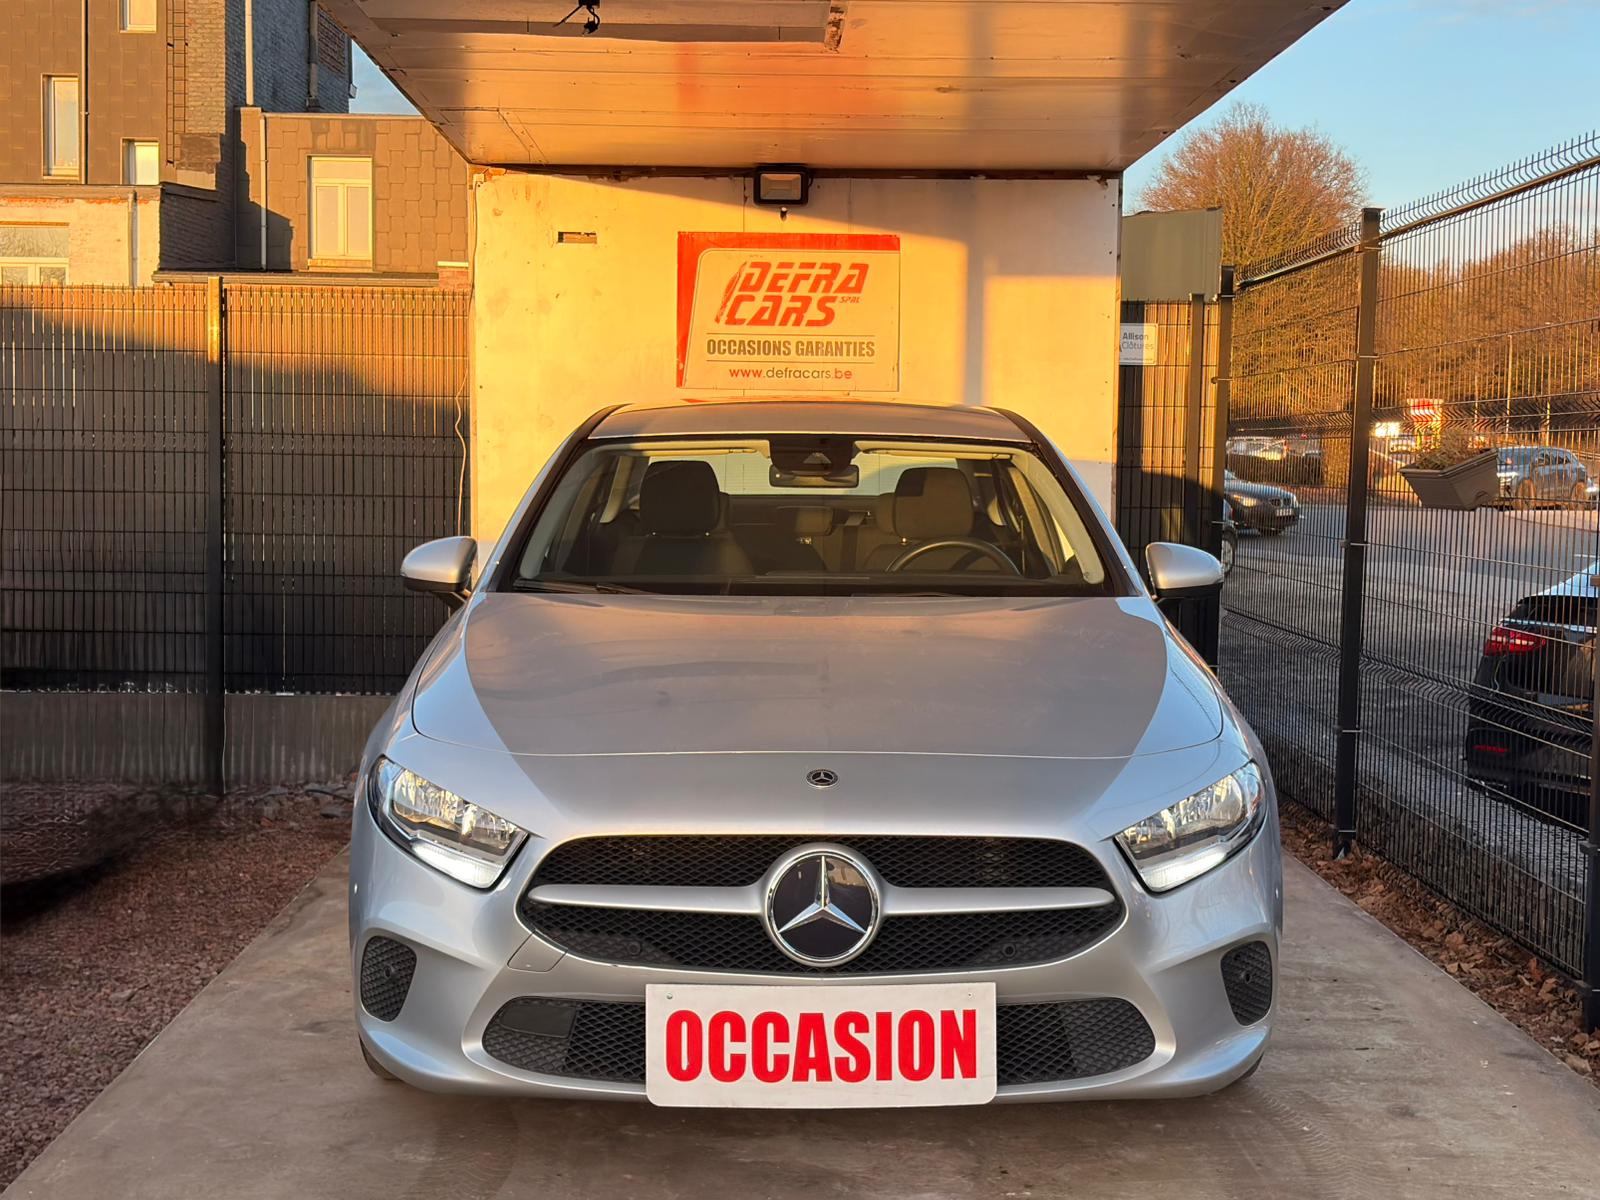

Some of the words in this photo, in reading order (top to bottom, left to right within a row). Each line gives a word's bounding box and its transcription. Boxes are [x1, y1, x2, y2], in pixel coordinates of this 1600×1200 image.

[738, 261, 870, 294] DEFRA
[724, 294, 837, 327] CARS
[706, 339, 792, 356] OCCASIONS
[795, 341, 875, 357] GARANTIES
[1122, 332, 1149, 341] Allison
[729, 367, 853, 380] www.defracars.be
[666, 1009, 977, 1083] OCCASION
